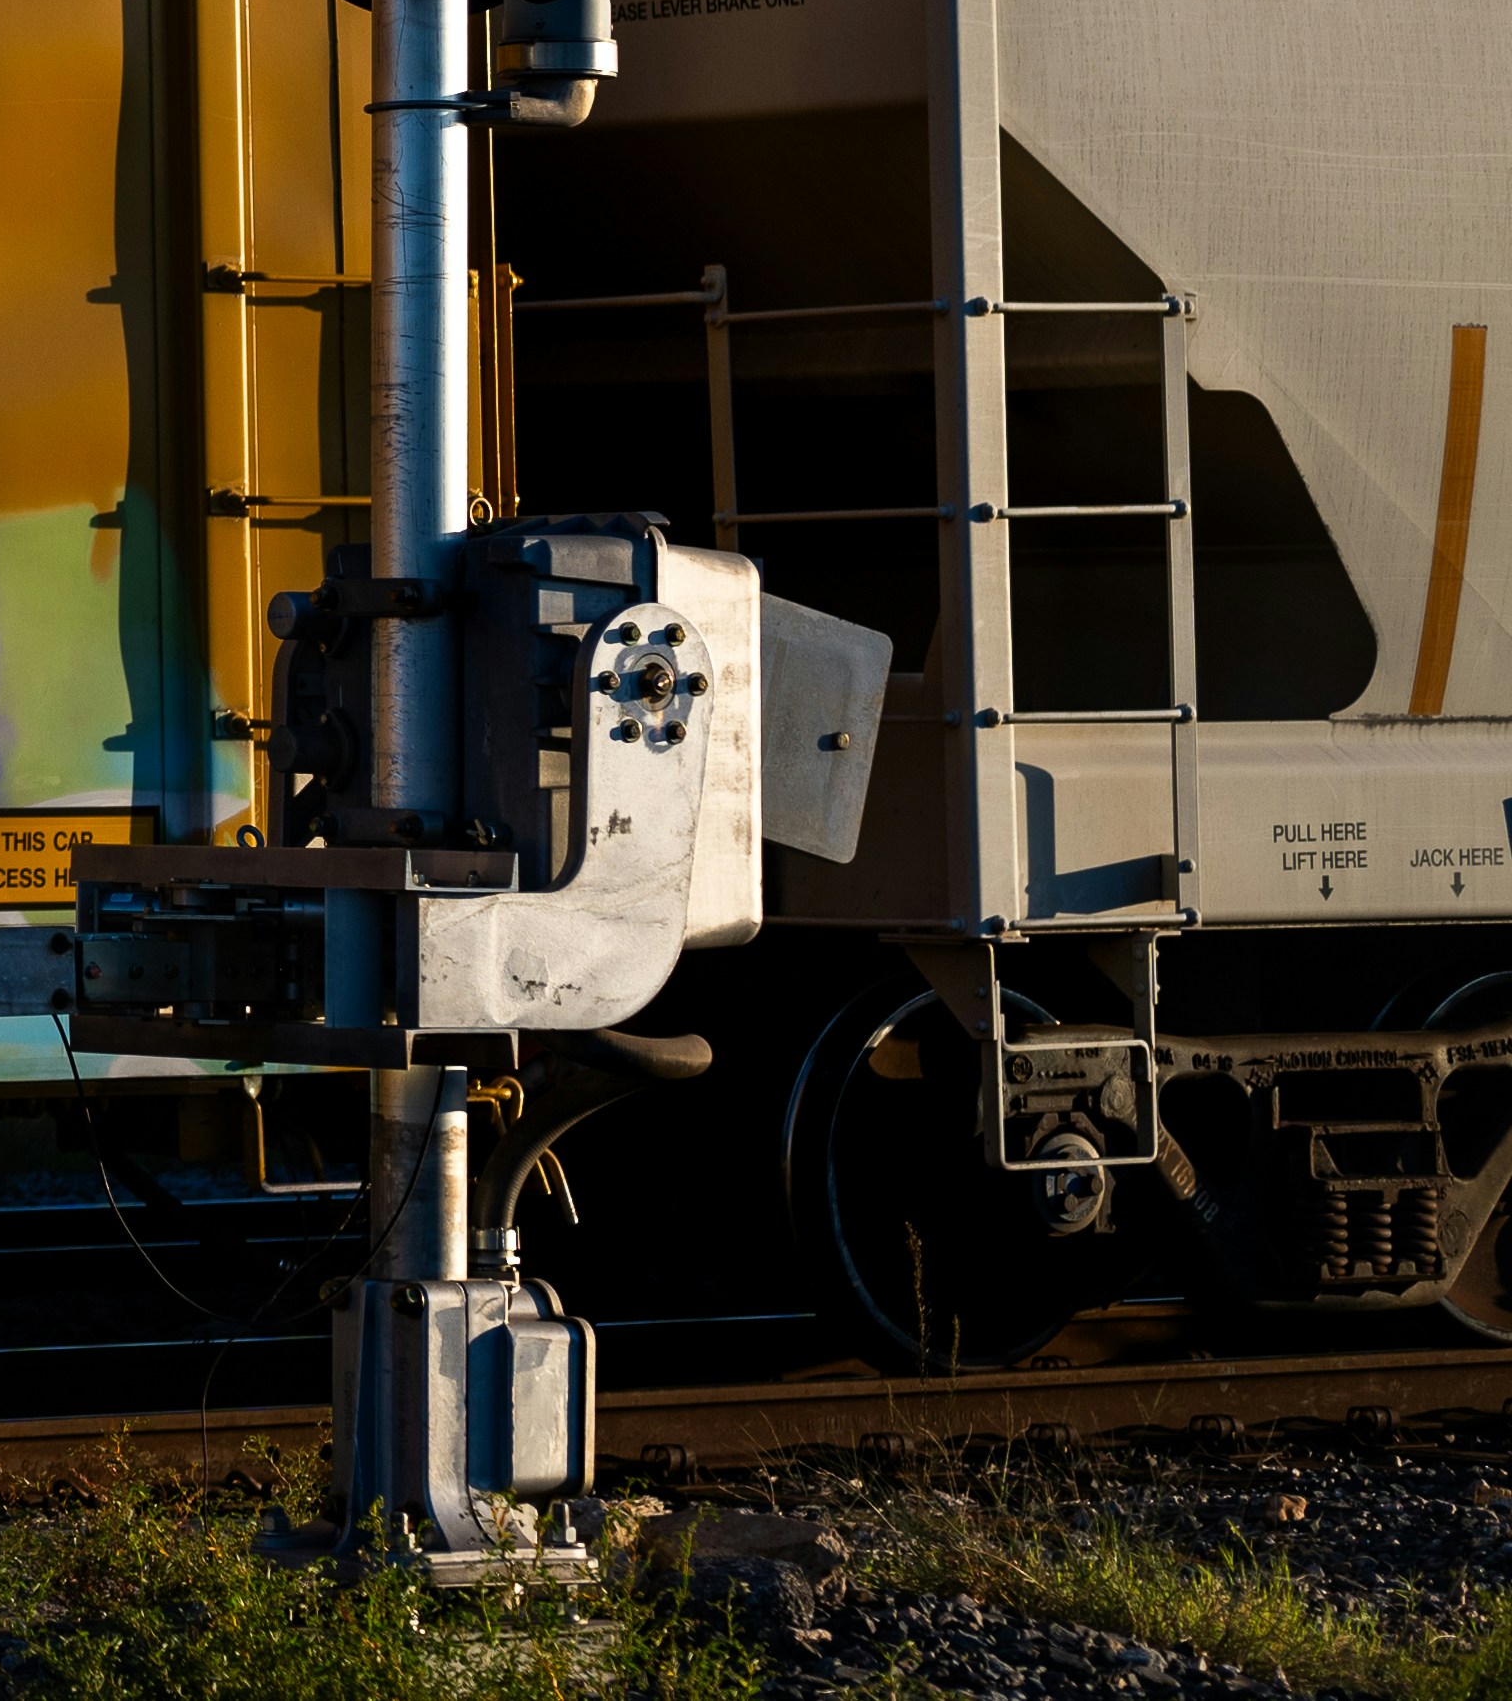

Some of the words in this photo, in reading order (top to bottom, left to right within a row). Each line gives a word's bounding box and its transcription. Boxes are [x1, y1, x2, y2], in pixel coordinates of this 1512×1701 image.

[1, 831, 46, 852] THIS
[1273, 824, 1317, 843] PULL
[1321, 822, 1367, 842] HERE
[1283, 851, 1317, 870] LIFT
[1322, 850, 1368, 869] HERE
[1410, 848, 1455, 868] JACK
[1459, 847, 1504, 866] HERE
